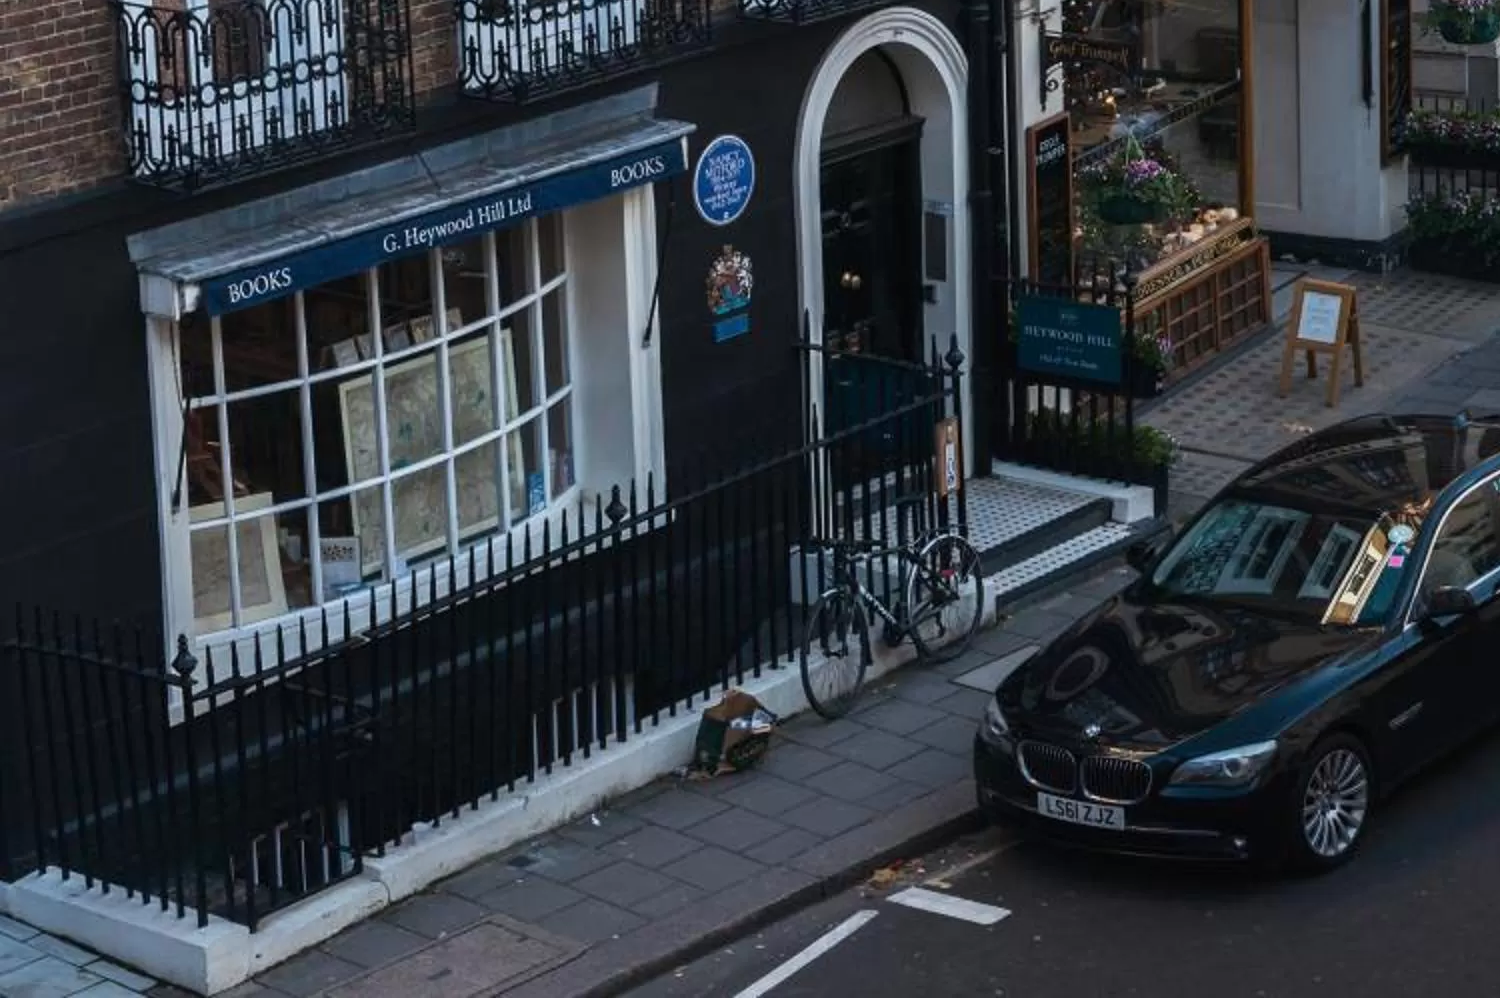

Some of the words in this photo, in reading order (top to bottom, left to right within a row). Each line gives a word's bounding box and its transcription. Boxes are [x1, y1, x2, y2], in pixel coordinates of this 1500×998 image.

[227, 267, 293, 303] BOOKS
[383, 233, 401, 253] G.
[403, 209, 474, 249] Heywood
[477, 201, 506, 225] Hill
[508, 191, 533, 217] Ltd
[611, 155, 665, 187] BOOKS
[1024, 325, 1083, 344] HEYWOOD
[1087, 333, 1112, 347] HILL
[1045, 797, 1079, 822] LS61
[1083, 805, 1115, 825] ZJZ
